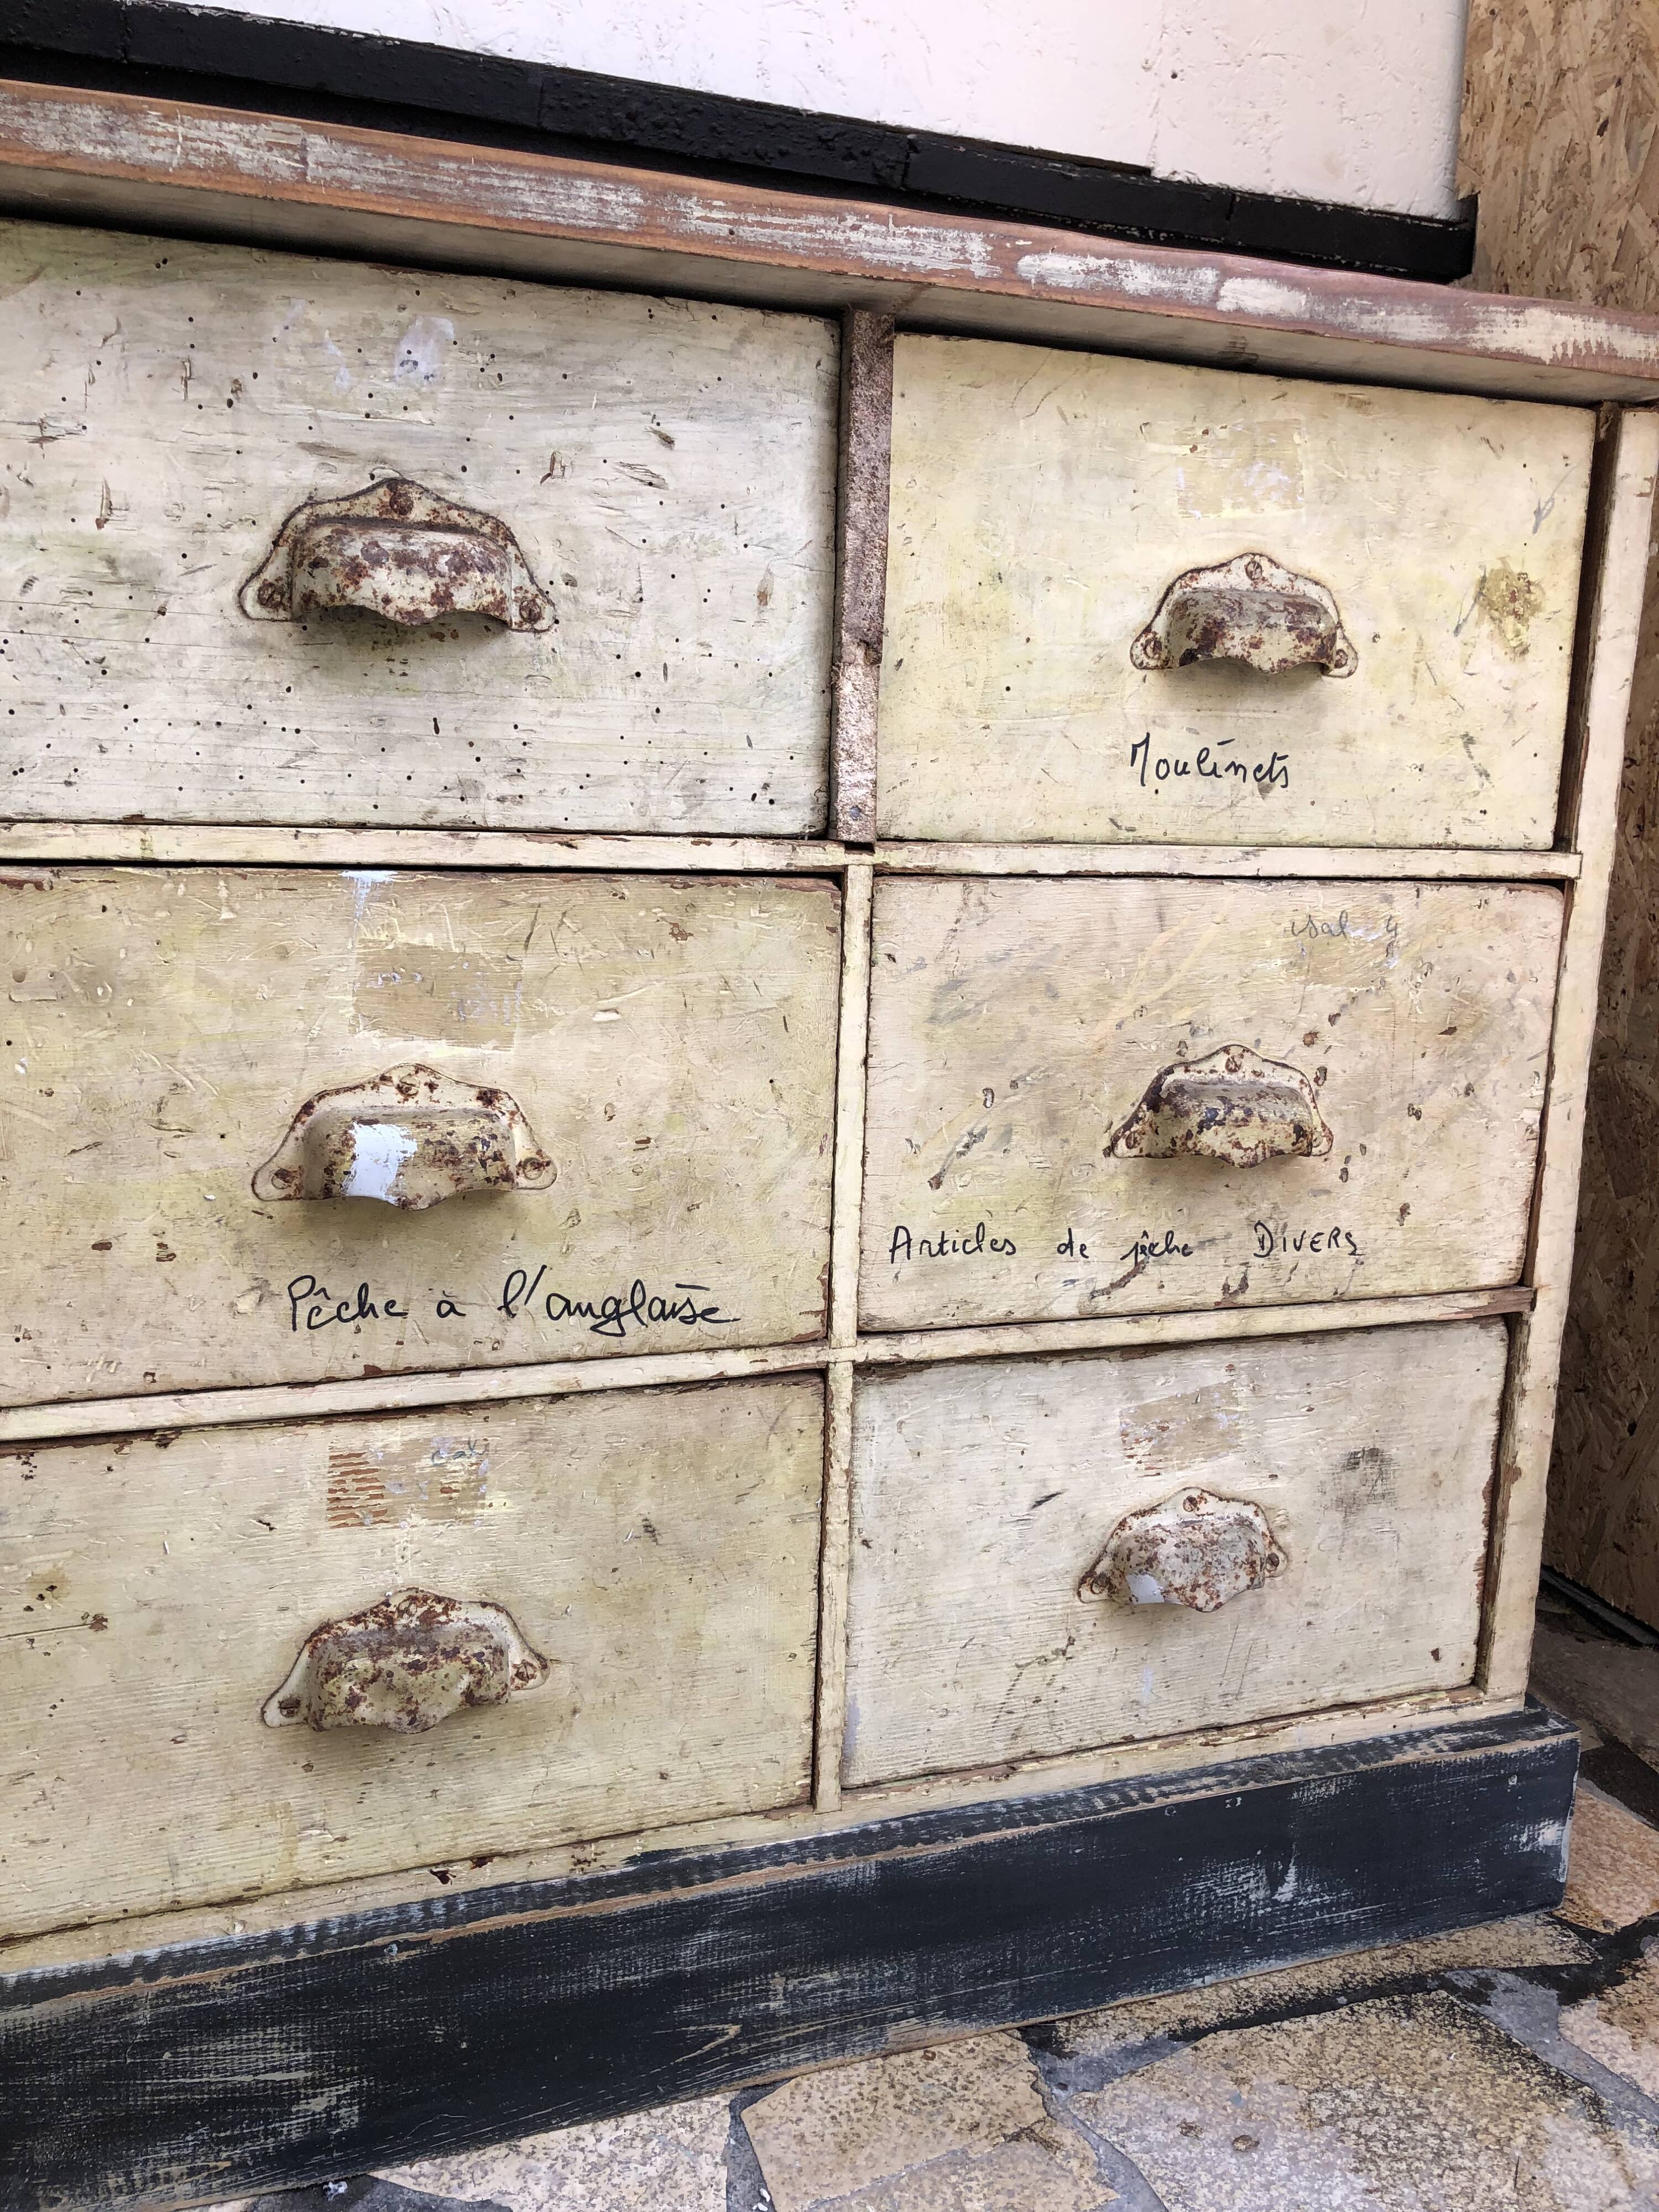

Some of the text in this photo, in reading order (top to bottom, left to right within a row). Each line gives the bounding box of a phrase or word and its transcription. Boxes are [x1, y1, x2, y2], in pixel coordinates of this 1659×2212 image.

[1130, 731, 1289, 789] Moulinets
[888, 1220, 1366, 1267] Articles de pêche DIVERS
[286, 1264, 742, 1338] Pêche à l'anglaise
